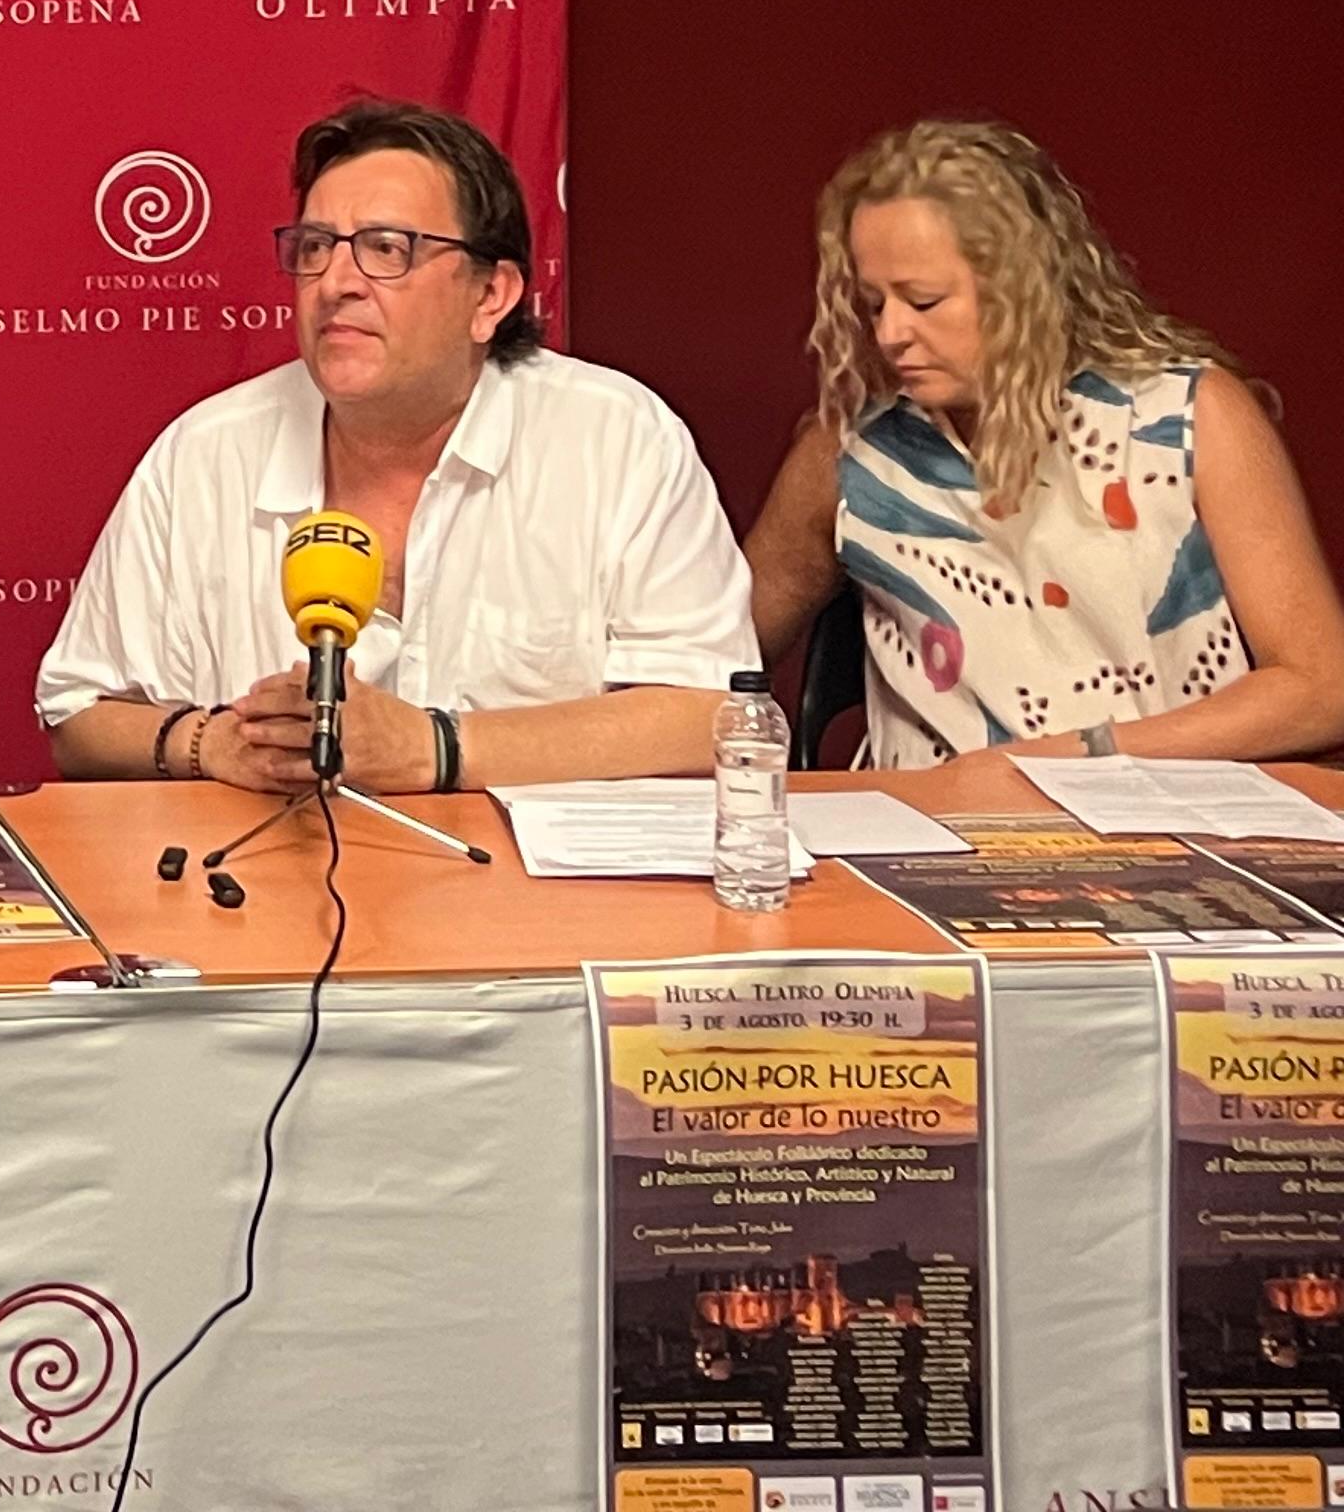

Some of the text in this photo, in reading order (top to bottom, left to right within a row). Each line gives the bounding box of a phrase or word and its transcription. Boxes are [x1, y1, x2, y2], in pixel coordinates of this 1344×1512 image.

[84, 272, 220, 290] FUNDACIÓN
[142, 306, 200, 332] PIE
[220, 305, 293, 330] SOP
[679, 1013, 692, 1030] 3
[703, 1014, 725, 1030] DE
[1248, 1001, 1262, 1019] 3
[642, 1061, 951, 1094] PASIÓN POR HUESCA
[1209, 1049, 1321, 1082] PASIÓN
[653, 1106, 941, 1133] El valor de lo nuestro
[1220, 1094, 1242, 1119] El
[1252, 1095, 1322, 1120] valor
